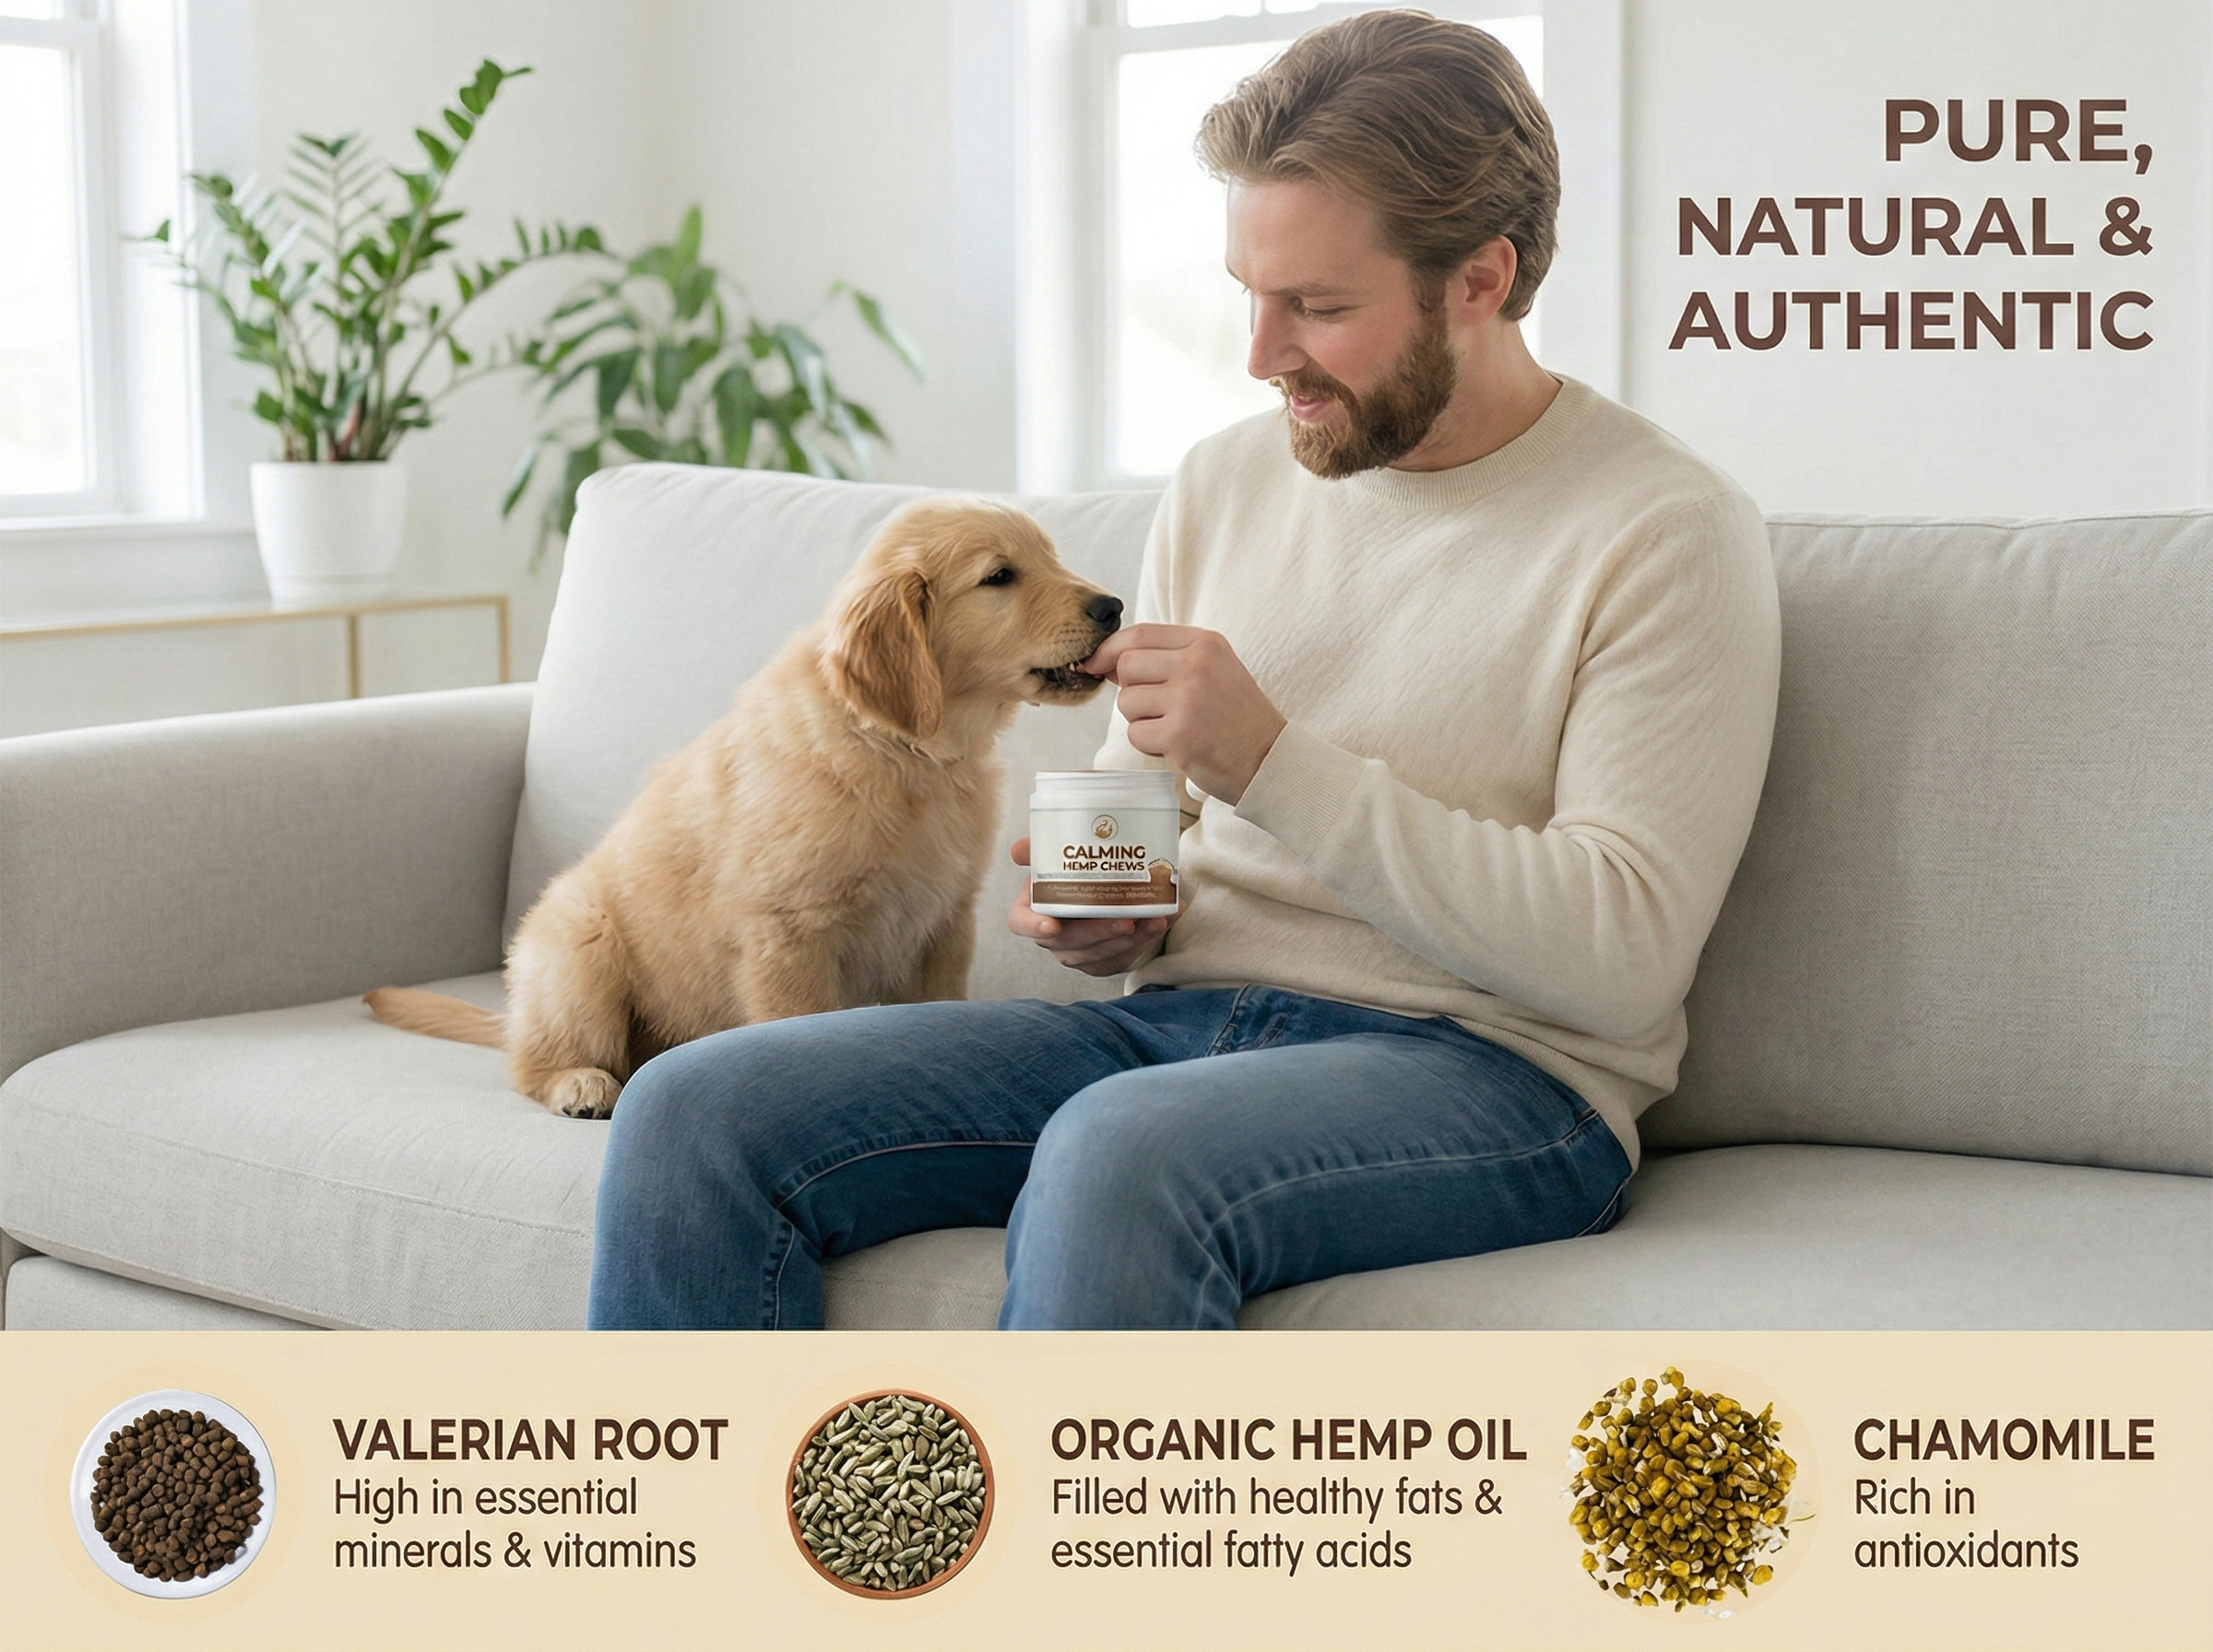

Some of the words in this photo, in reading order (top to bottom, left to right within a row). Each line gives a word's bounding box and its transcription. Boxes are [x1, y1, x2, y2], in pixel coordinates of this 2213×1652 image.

[1063, 844, 1146, 860] CALMING
[1063, 861, 1098, 871] HEMP
[1100, 861, 1145, 871] CHEWS
